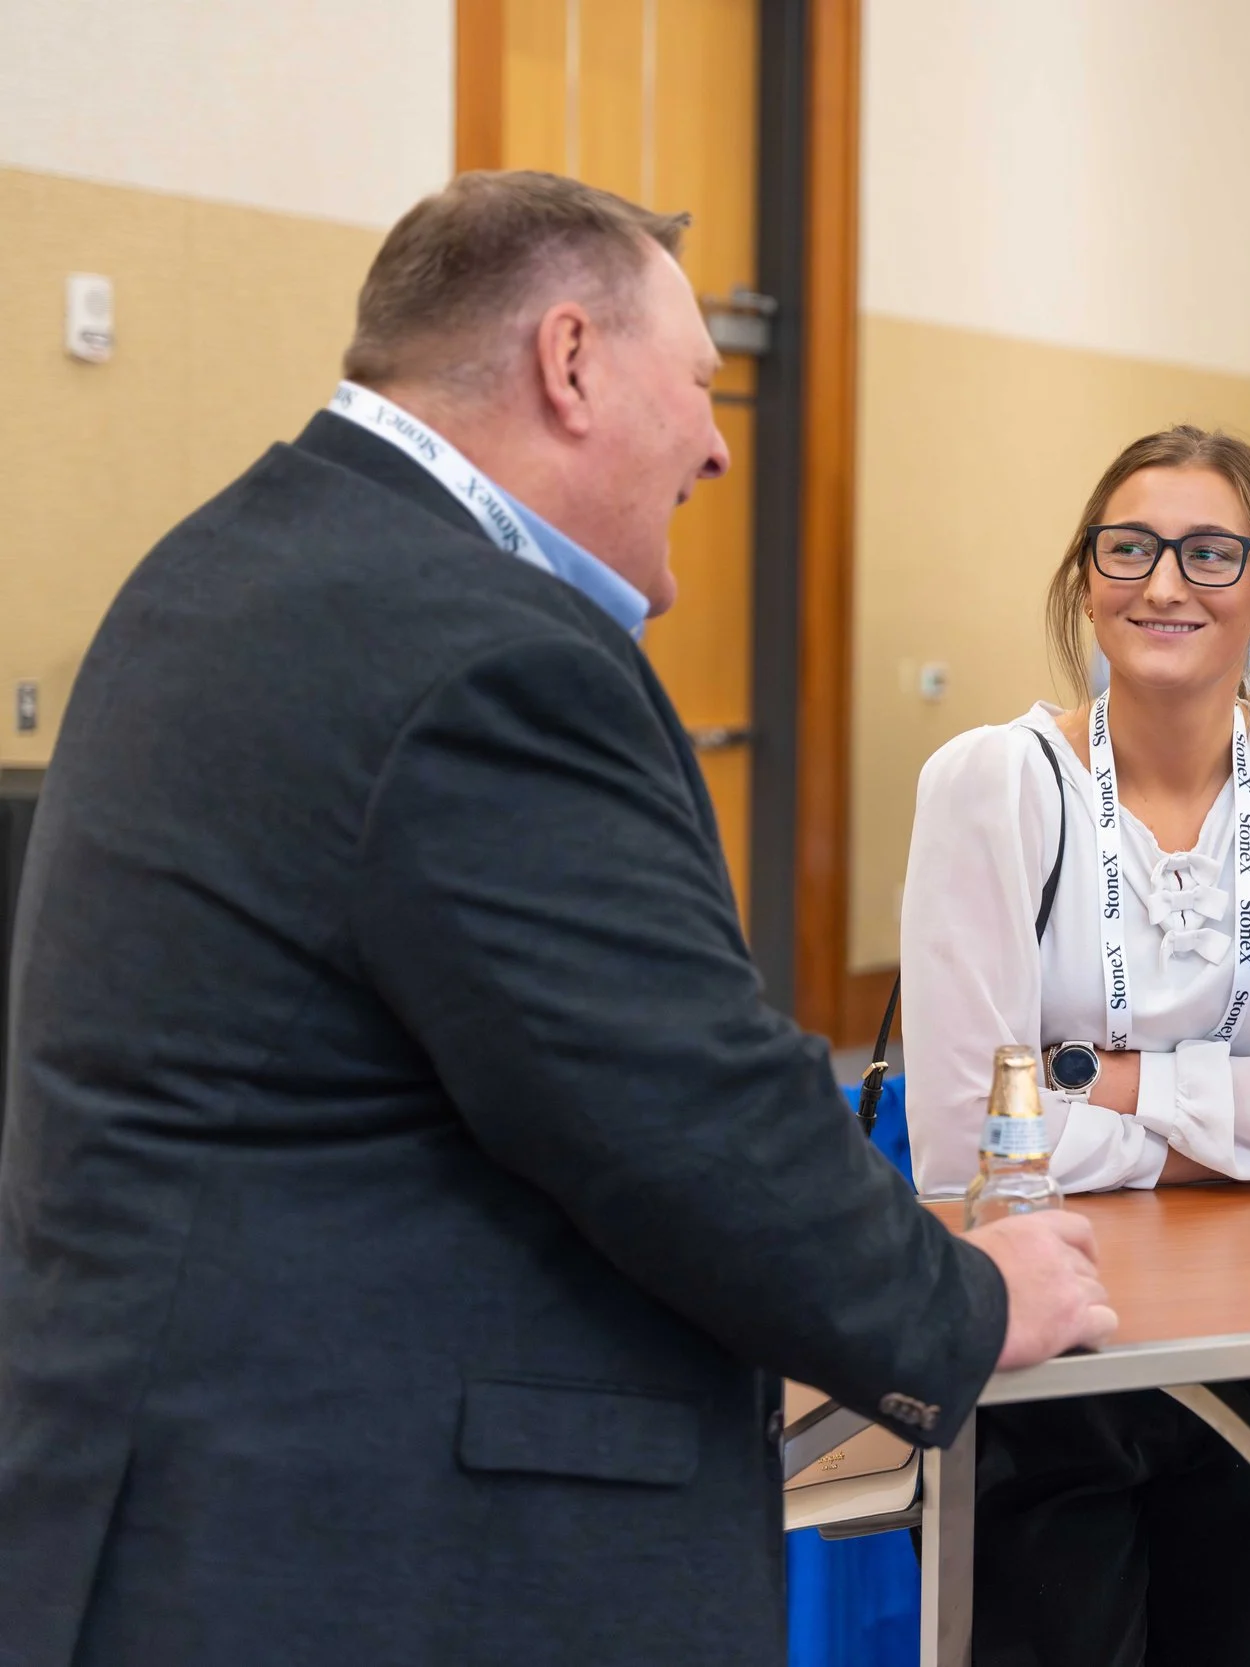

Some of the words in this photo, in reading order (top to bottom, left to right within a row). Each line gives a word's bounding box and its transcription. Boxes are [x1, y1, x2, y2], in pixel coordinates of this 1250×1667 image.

[1096, 767, 1116, 829] StoneX
[1102, 850, 1121, 920] StoneX
[1106, 941, 1127, 1010] StoneX
